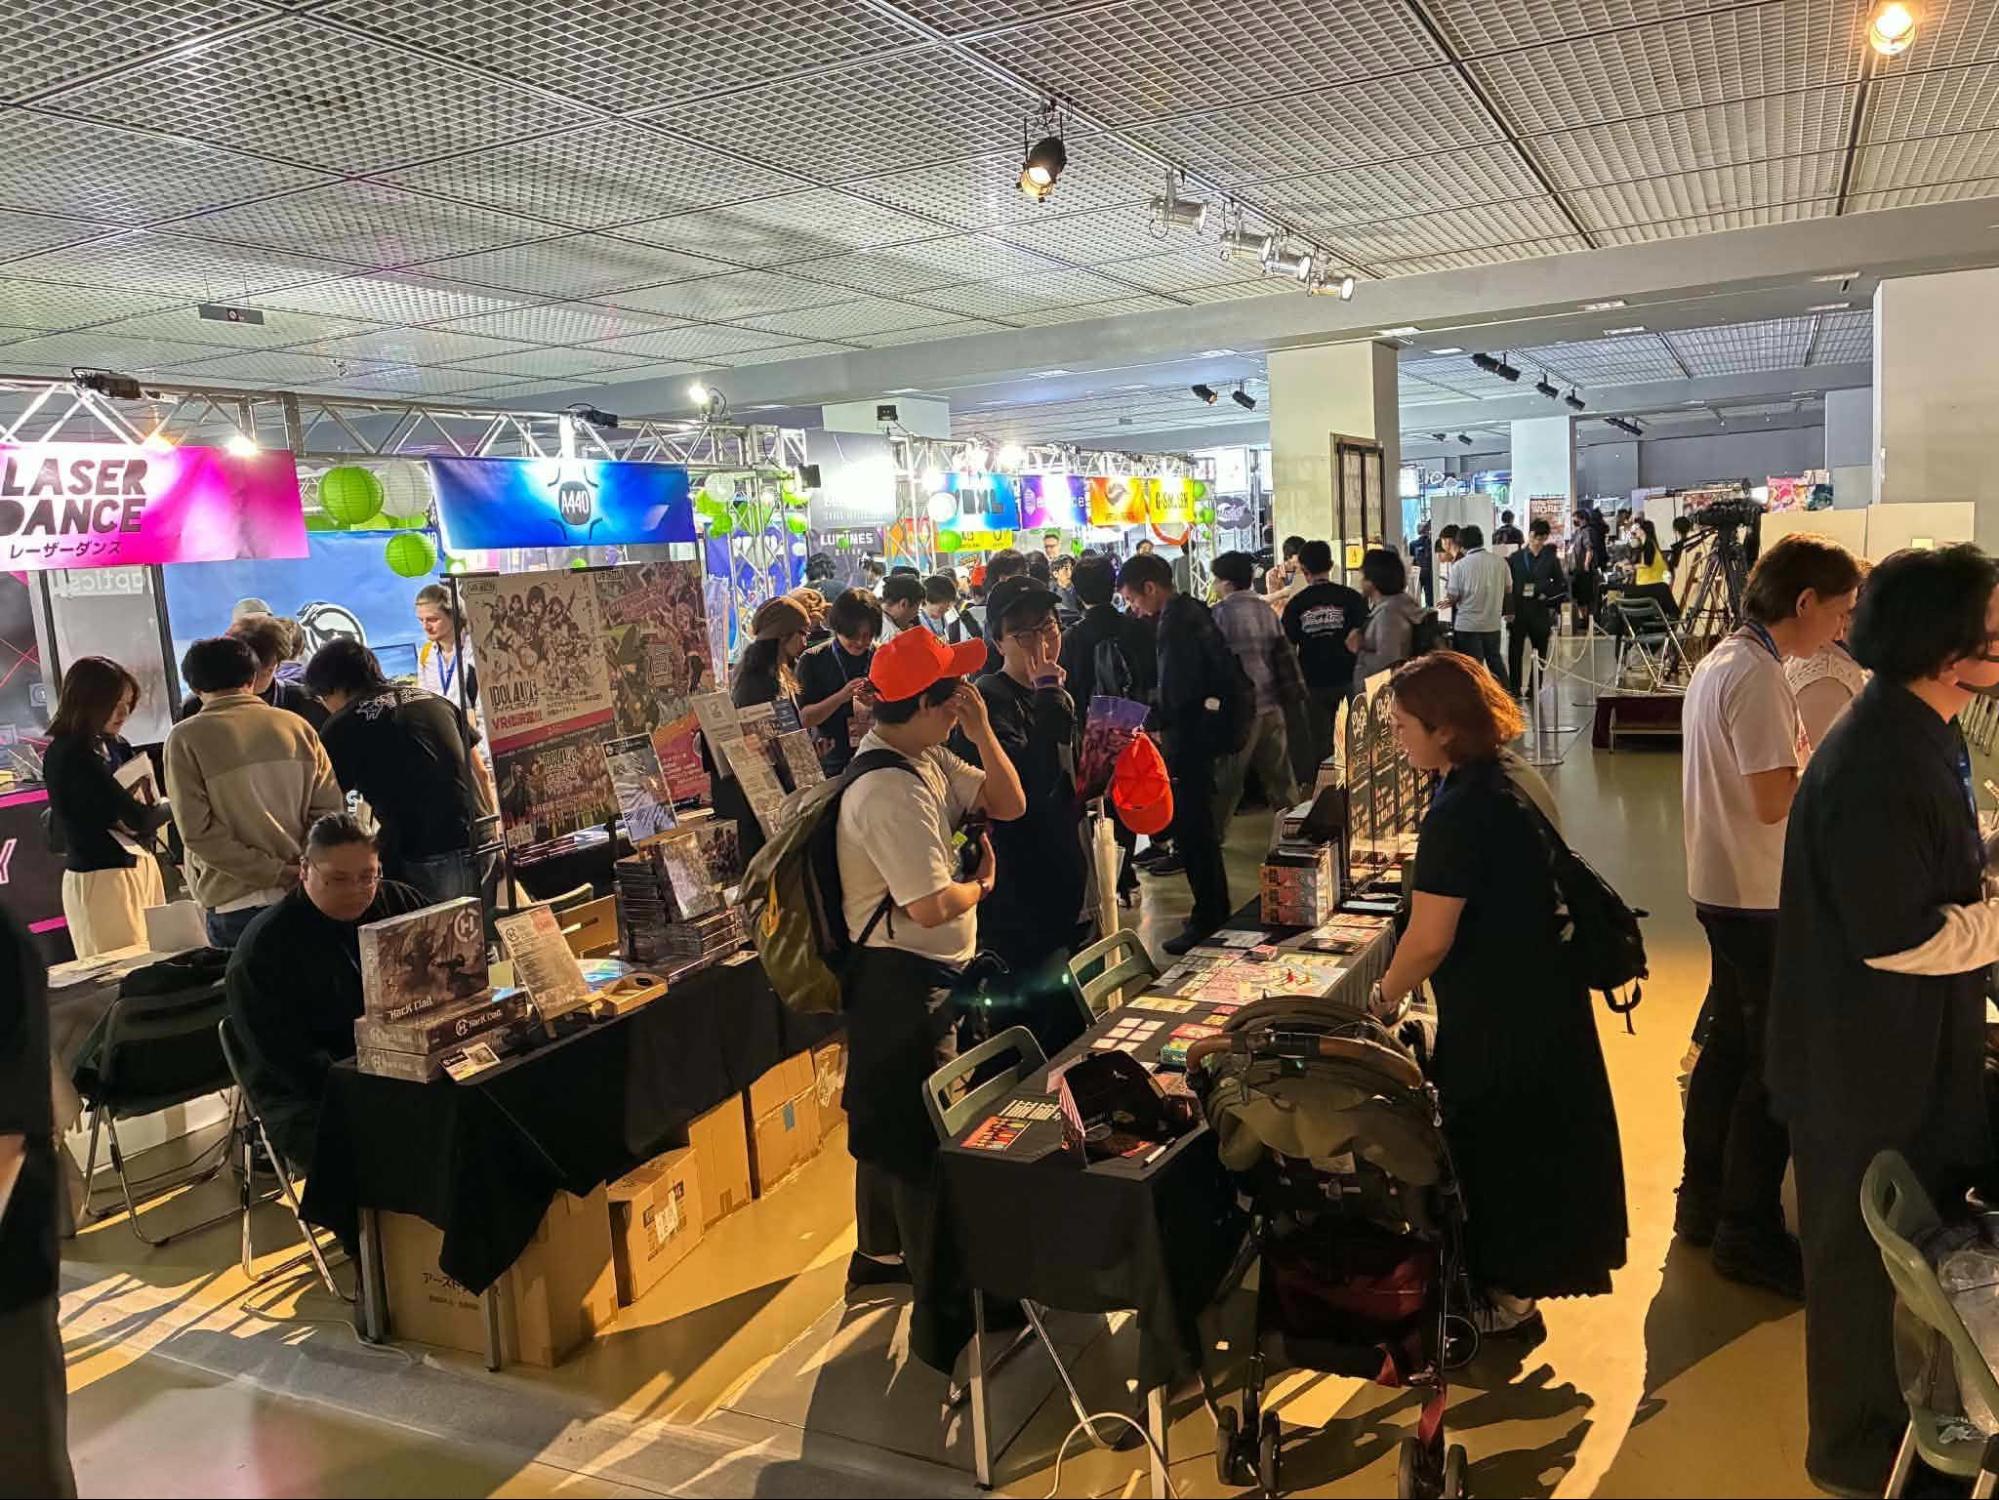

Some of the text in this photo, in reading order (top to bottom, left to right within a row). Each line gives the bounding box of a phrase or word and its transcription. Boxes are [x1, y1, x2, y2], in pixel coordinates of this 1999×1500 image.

[2, 457, 148, 496] LASER
[561, 490, 589, 514] A440
[0, 499, 147, 536] DANCE
[10, 540, 121, 559] レーザーダンス
